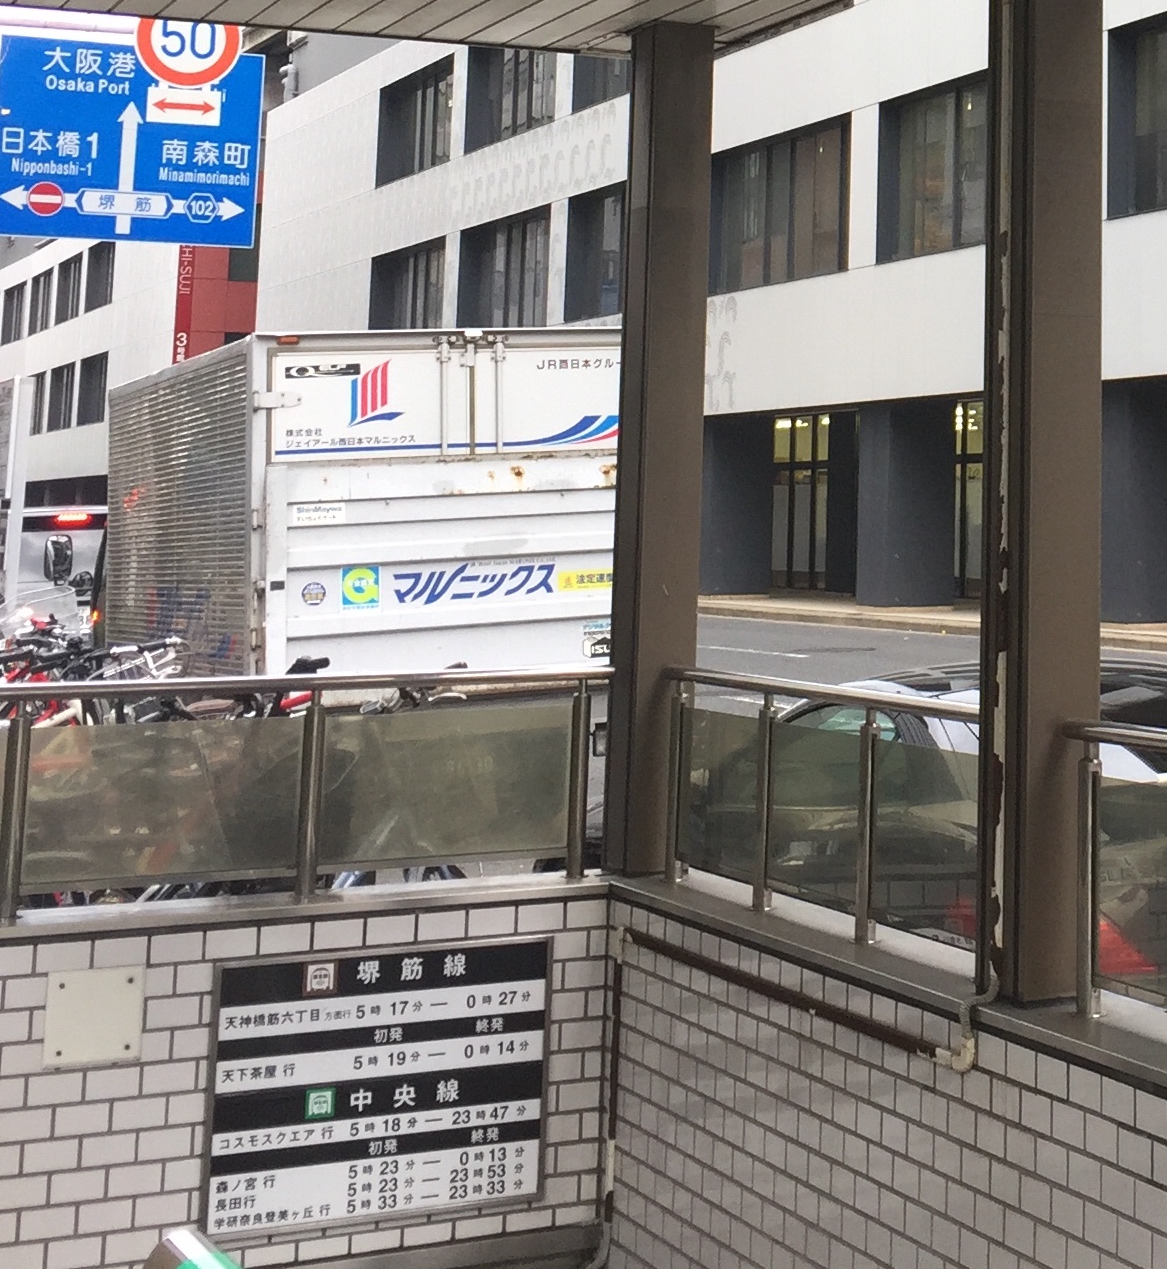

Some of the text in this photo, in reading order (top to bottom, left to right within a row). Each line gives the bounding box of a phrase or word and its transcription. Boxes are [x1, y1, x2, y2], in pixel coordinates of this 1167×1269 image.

[161, 20, 216, 59] 50
[43, 47, 136, 78] 大阪港
[46, 75, 130, 95] Osaka Port
[2, 127, 99, 160] 日本橋1
[162, 139, 251, 169] 南森町
[11, 157, 92, 177] Nipponbashi-1
[159, 167, 250, 187] Minamimorimachi
[98, 194, 152, 212] 堺筋
[190, 201, 214, 216] 102
[285, 427, 323, 437] 株式会社
[286, 435, 416, 448] ジェイアール西日本マルニックス
[392, 562, 556, 605] マルニックス
[356, 953, 467, 985] 堺筋線
[373, 1017, 505, 1044] 初発 終発
[350, 1078, 460, 1112] 中央線
[368, 1127, 500, 1156] 初発 終発
[215, 1194, 257, 1213] 長田行
